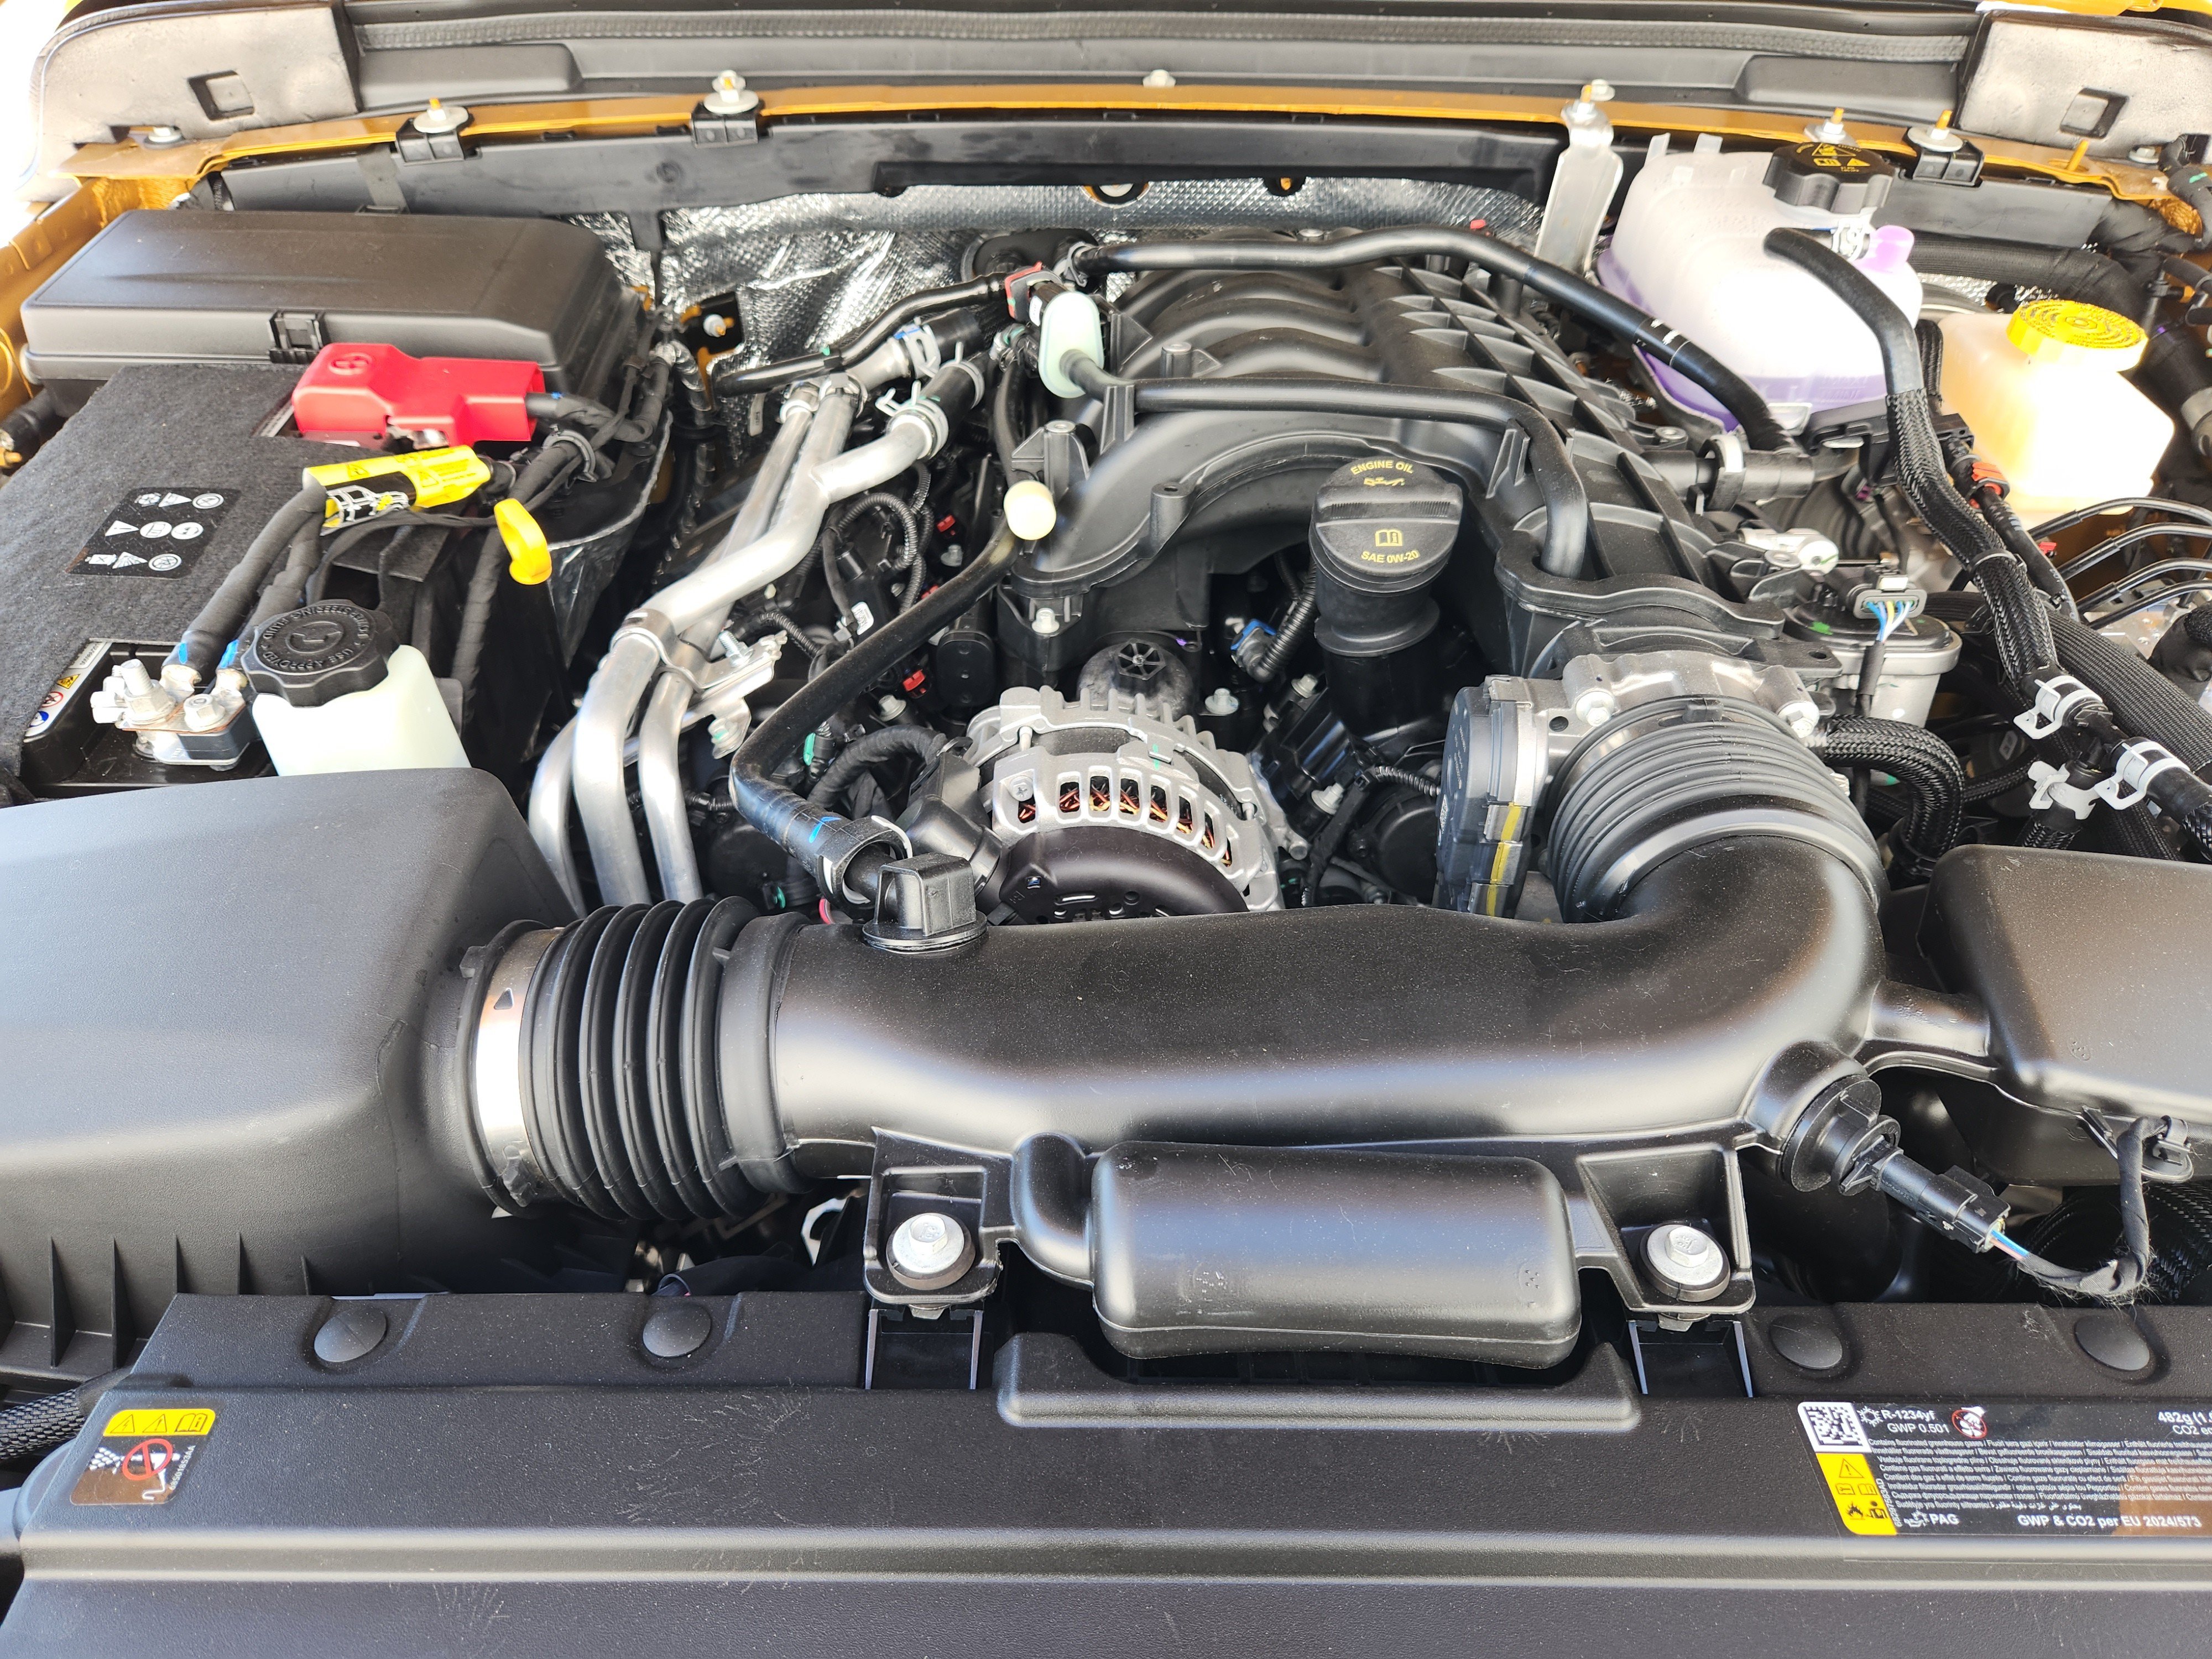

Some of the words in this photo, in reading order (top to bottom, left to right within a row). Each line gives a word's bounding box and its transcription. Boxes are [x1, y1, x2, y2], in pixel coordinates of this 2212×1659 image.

[1350, 461, 1393, 475] ENGINE
[1396, 461, 1414, 474] OIL
[1361, 550, 1384, 563] SAE
[1387, 549, 1420, 564] 0W-20
[1881, 1408, 1936, 1422] R-1234yf
[2158, 1411, 2194, 1425] 482g
[1887, 1423, 1916, 1433] GWP
[1919, 1423, 1950, 1433] 0.501
[2172, 1425, 2200, 1435] CO2
[1928, 1514, 1961, 1526] PAG
[2017, 1516, 2050, 1527] GWP
[2056, 1516, 2066, 1527] &
[2068, 1516, 2096, 1527] CO2
[2098, 1517, 2119, 1528] per
[2121, 1516, 2141, 1527] EU
[2144, 1516, 2202, 1528] 2024/573
